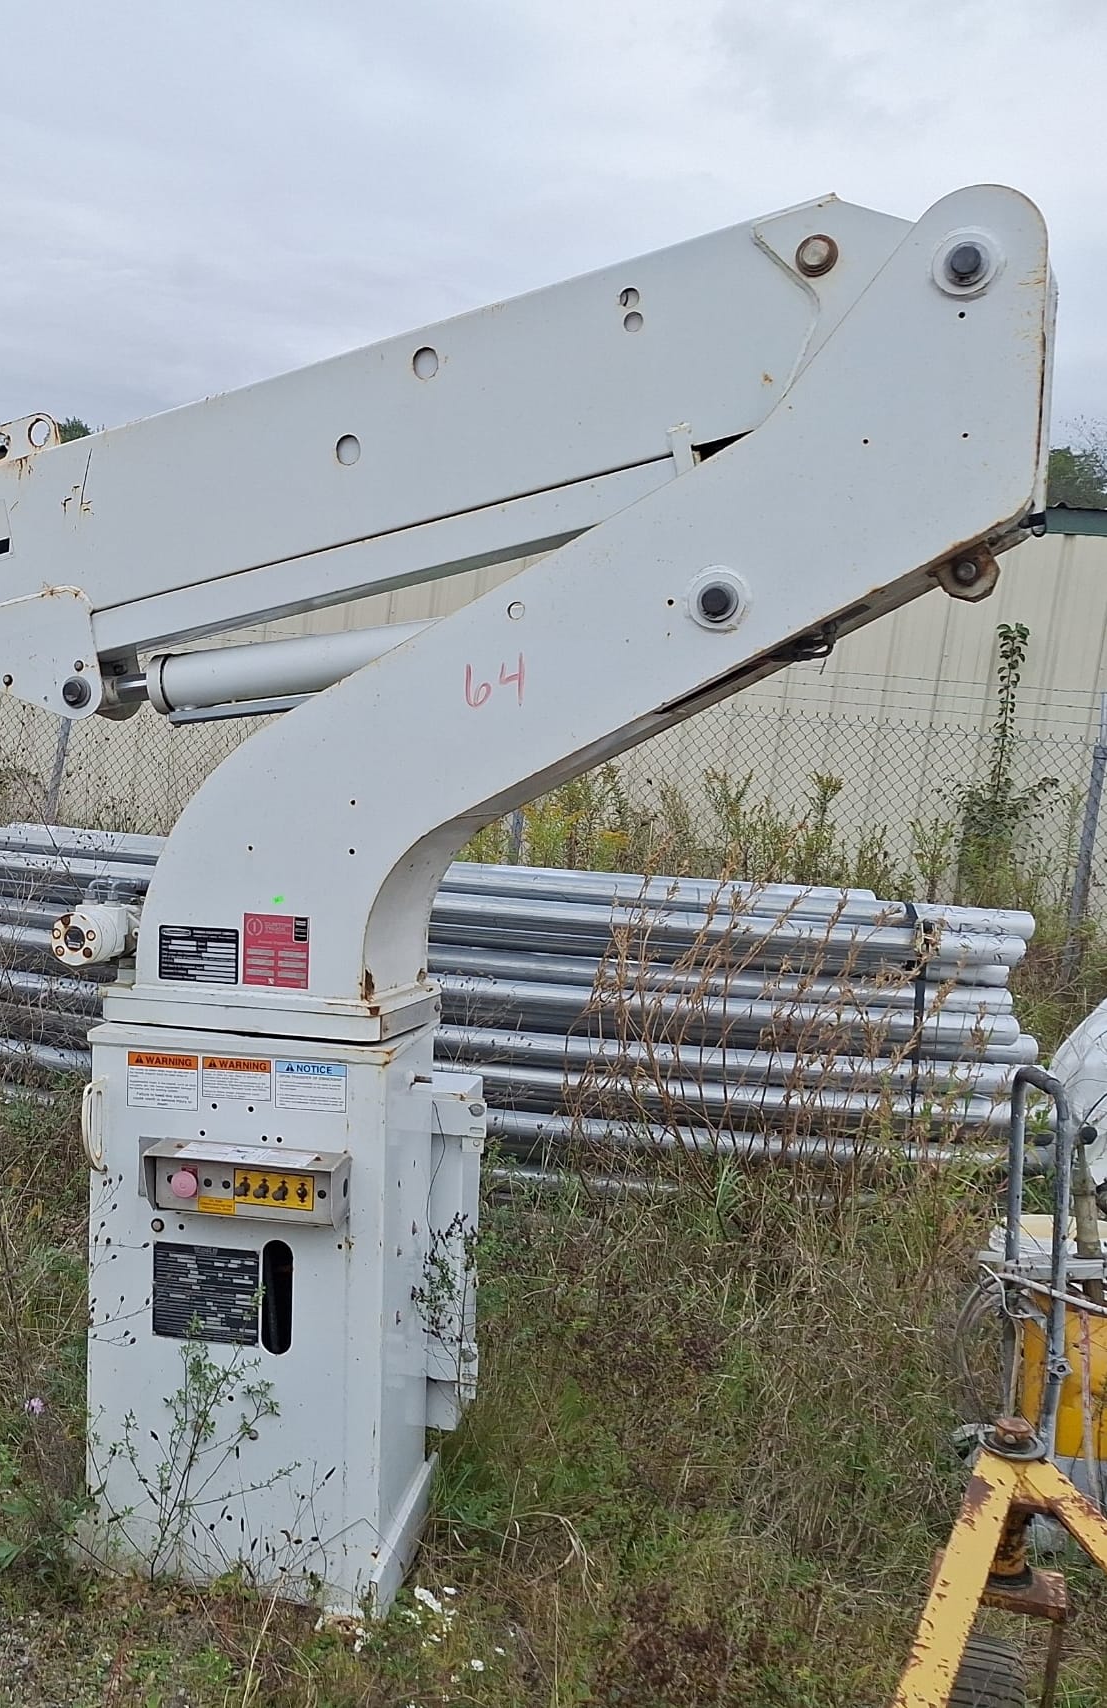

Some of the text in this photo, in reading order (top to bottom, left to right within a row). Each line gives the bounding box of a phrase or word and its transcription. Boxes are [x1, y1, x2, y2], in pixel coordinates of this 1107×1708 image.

[465, 651, 525, 708] 64
[145, 1055, 192, 1067] WARNING
[219, 1059, 267, 1071] WARNING
[296, 1064, 333, 1075] NOTICE
